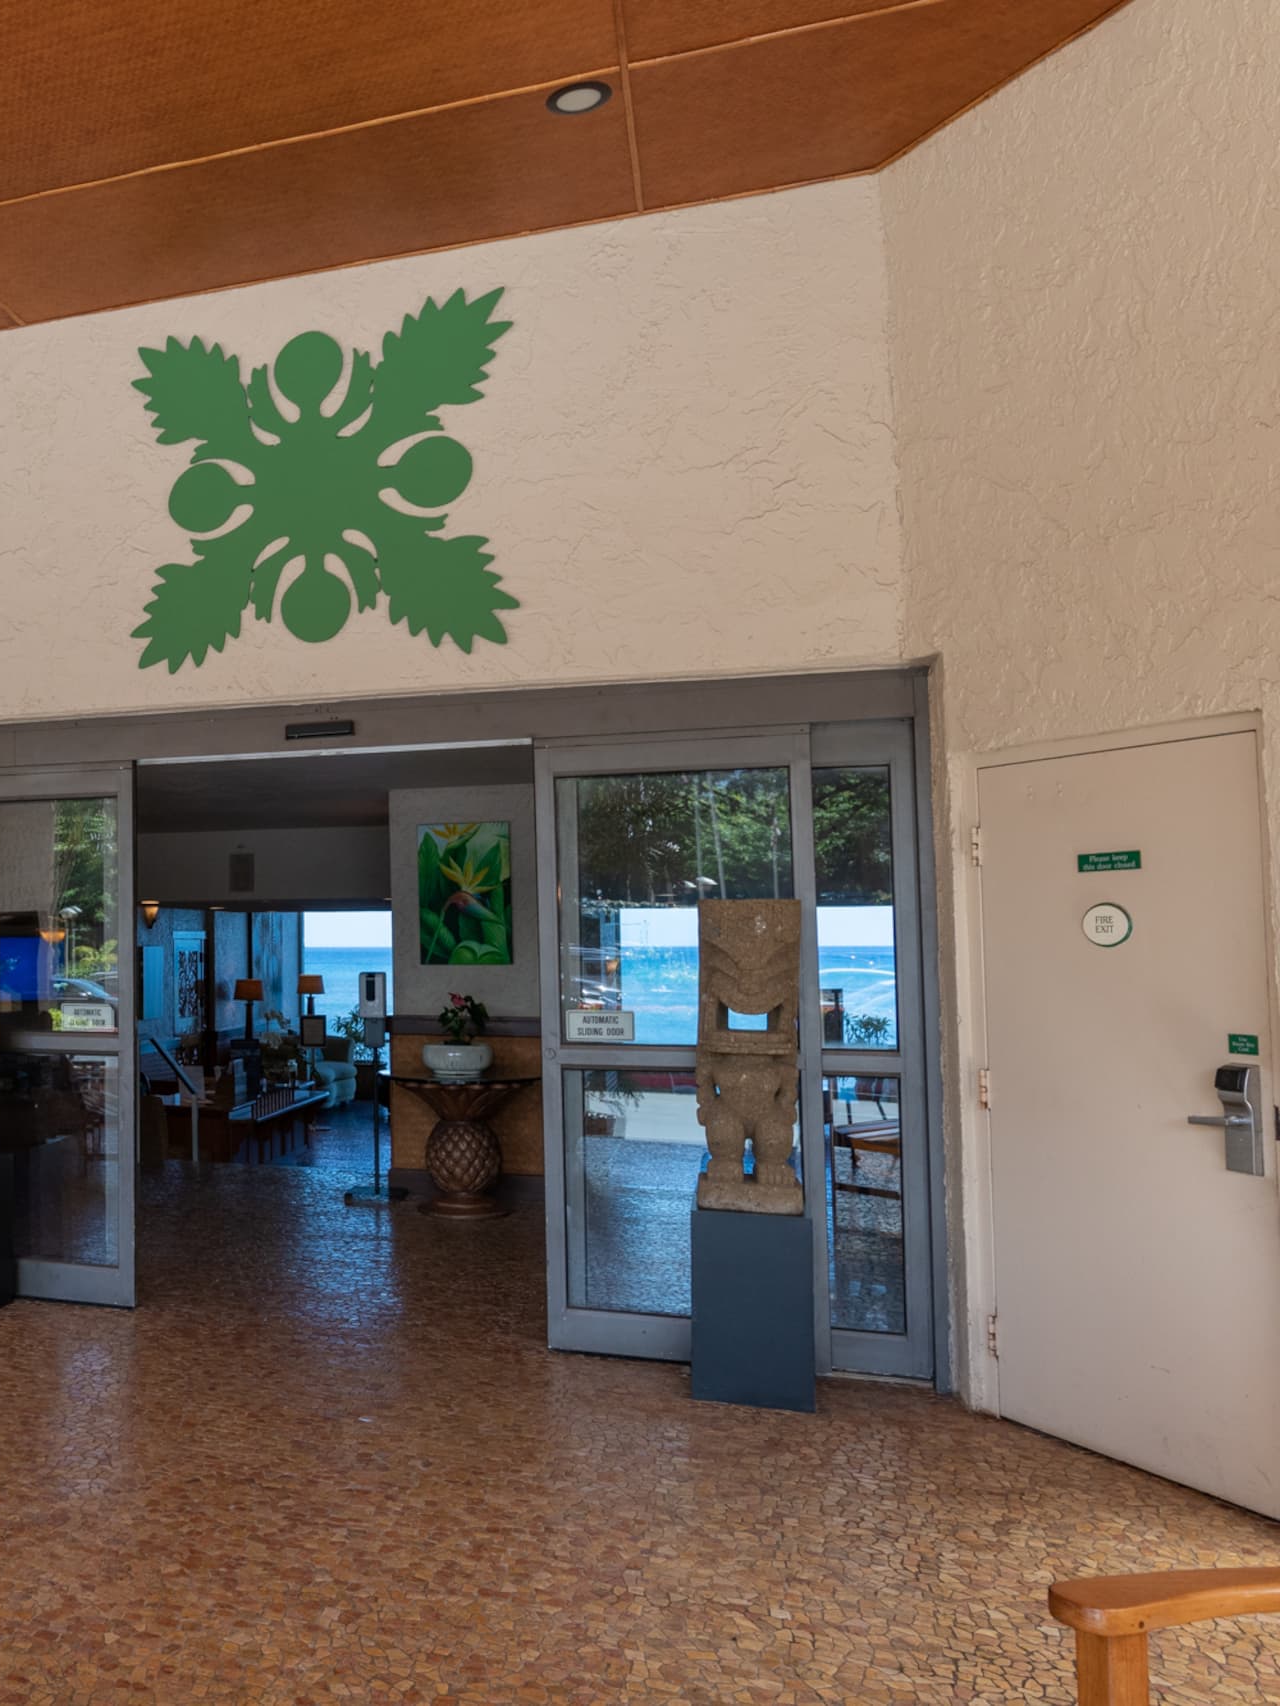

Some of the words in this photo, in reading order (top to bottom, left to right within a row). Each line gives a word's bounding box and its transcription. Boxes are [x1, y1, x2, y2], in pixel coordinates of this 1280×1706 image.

[1095, 916, 1114, 924] FIRE
[1095, 925, 1114, 933] EXIT
[582, 1015, 619, 1024] AUTOMATIC
[577, 1027, 604, 1036] SLIDING
[606, 1027, 625, 1036] DOOR
